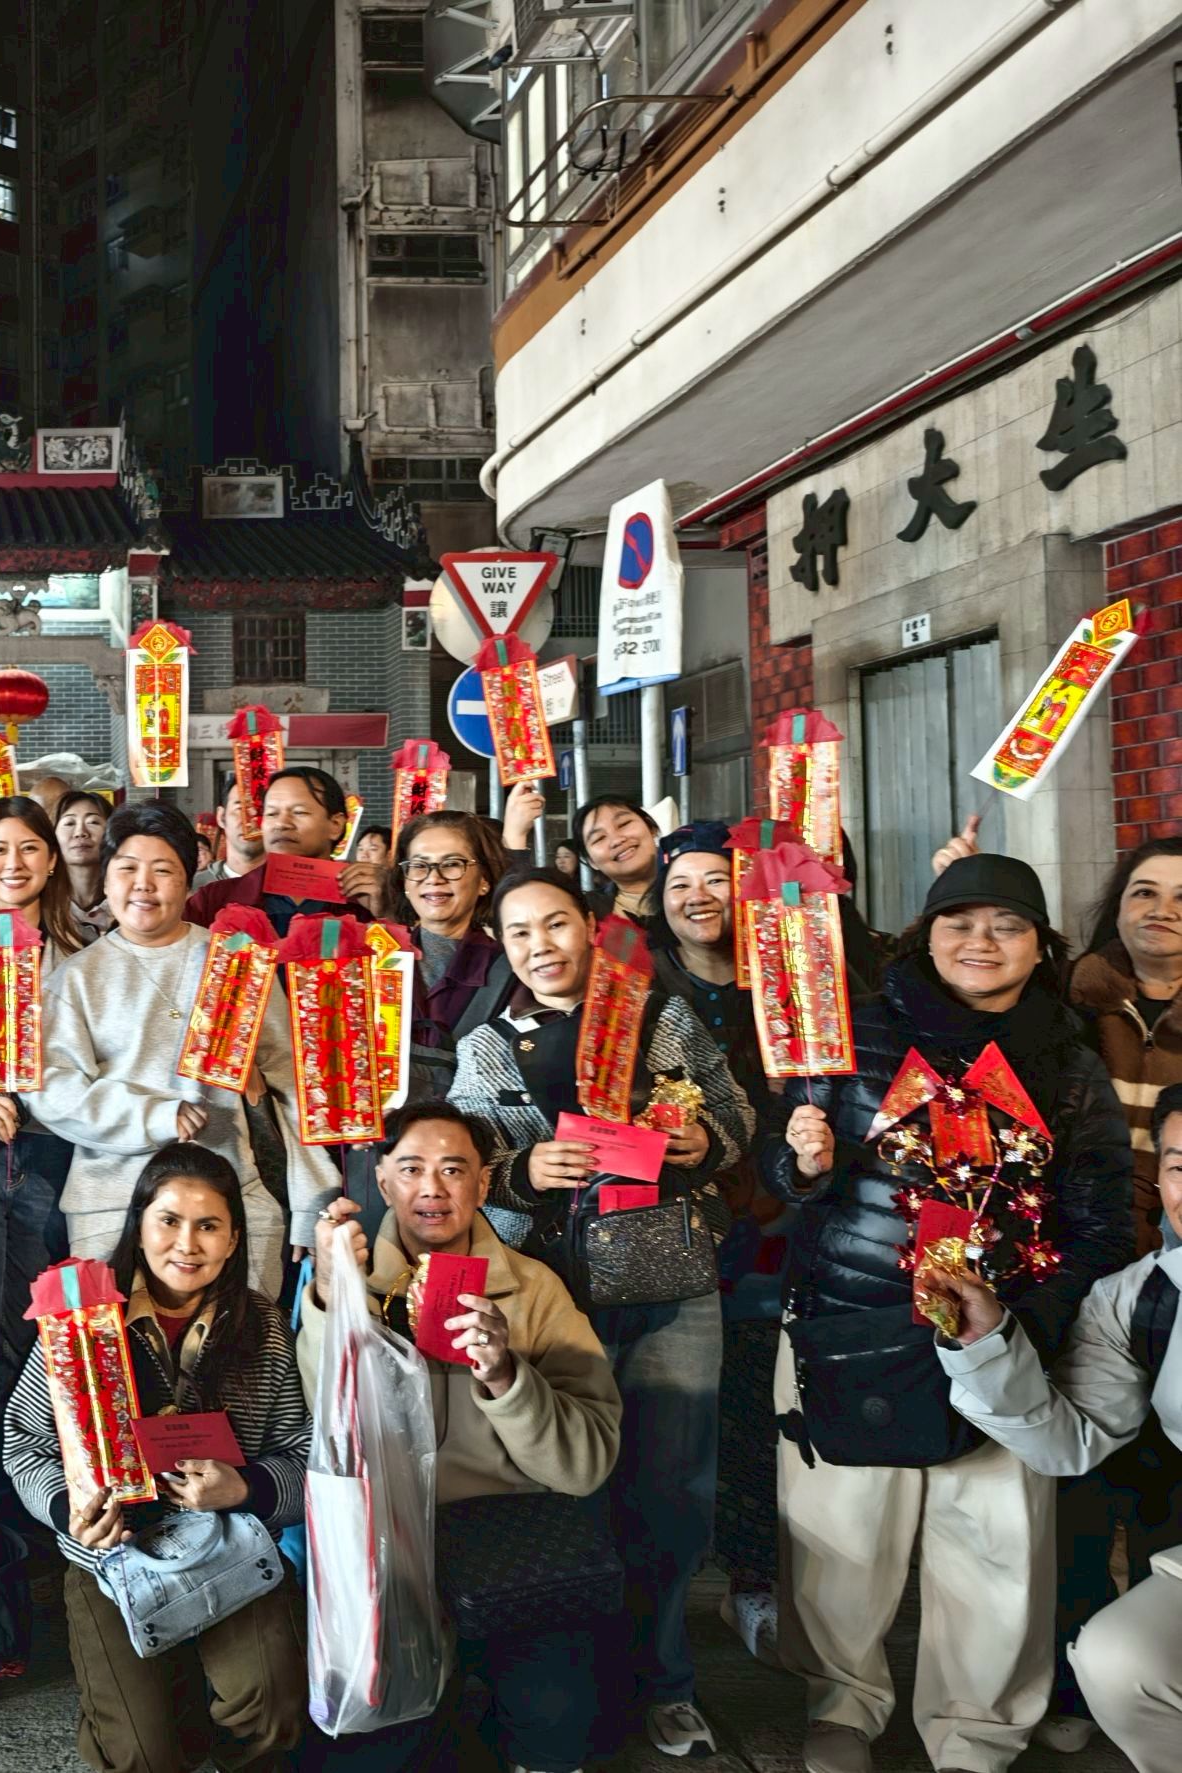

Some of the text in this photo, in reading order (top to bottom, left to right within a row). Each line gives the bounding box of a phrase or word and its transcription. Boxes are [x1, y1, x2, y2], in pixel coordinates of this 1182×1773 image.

[481, 566, 517, 579] GIVE
[482, 582, 516, 594] WAY
[490, 600, 508, 618] 讓
